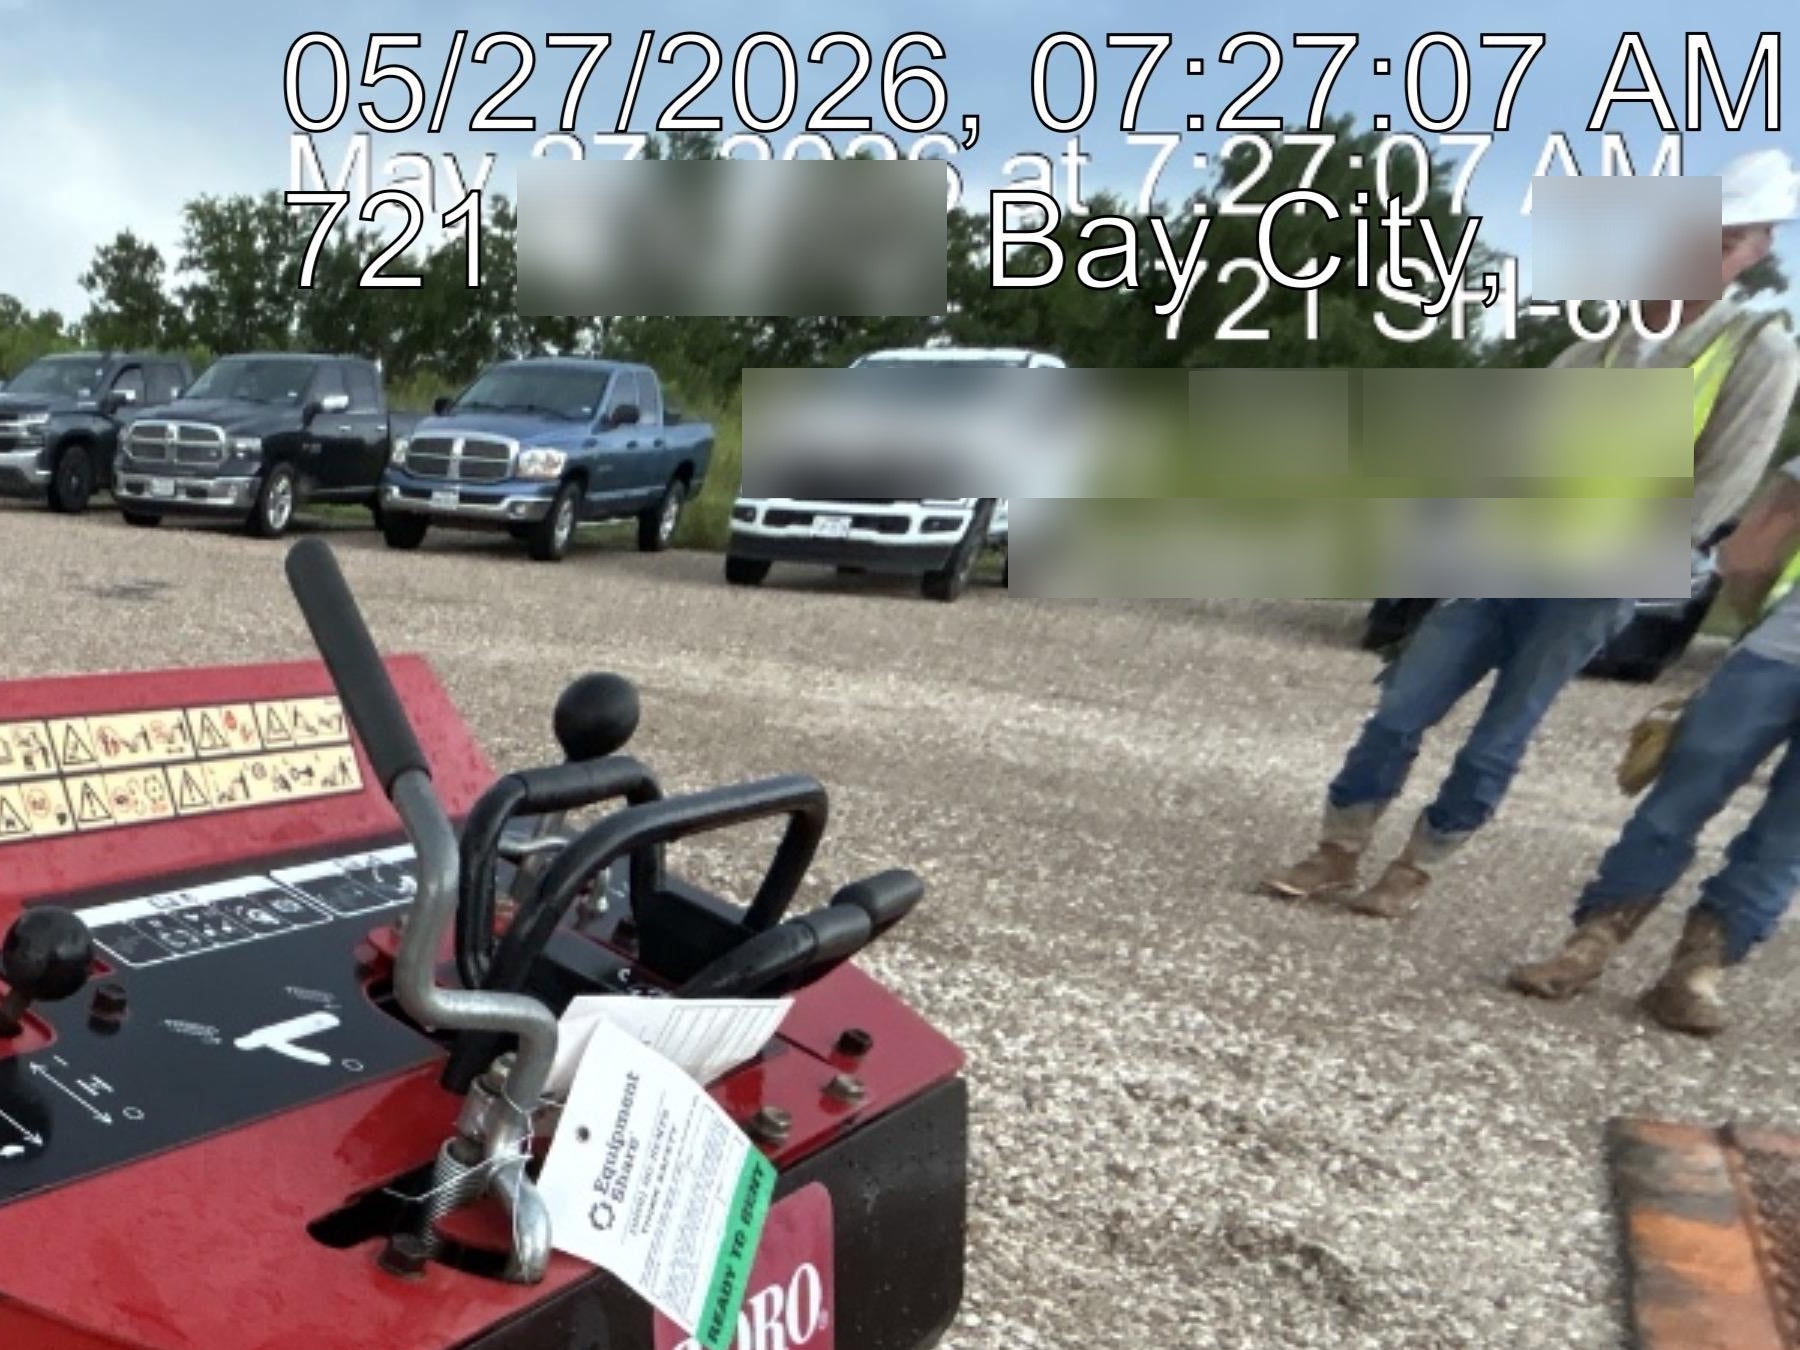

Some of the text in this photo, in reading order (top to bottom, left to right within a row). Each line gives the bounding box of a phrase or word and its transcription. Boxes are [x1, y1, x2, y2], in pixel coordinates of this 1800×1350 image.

[593, 1069, 640, 1196] Equipment
[611, 1133, 640, 1204] Share
[706, 1160, 767, 1345] READY TO RENT
